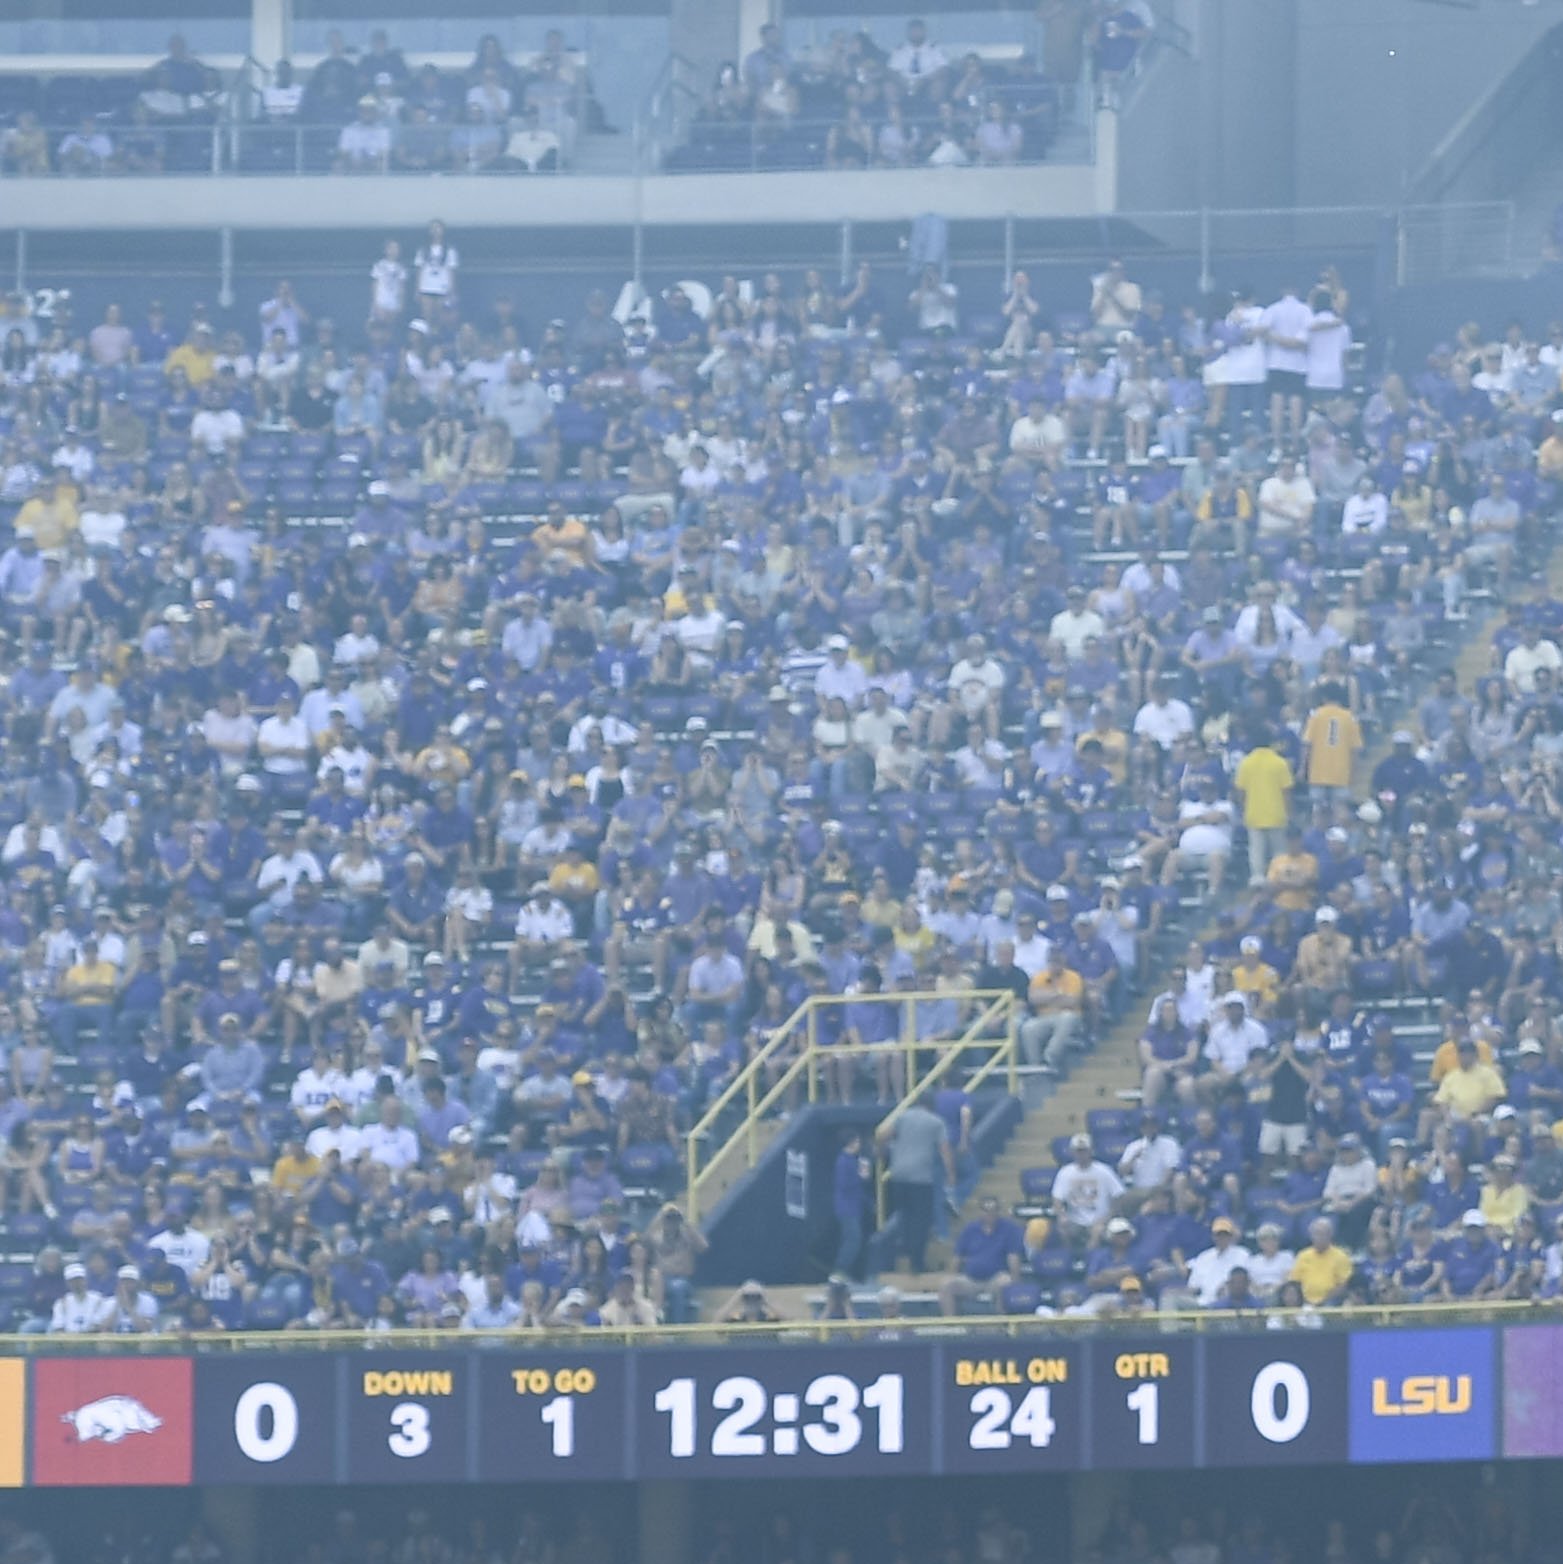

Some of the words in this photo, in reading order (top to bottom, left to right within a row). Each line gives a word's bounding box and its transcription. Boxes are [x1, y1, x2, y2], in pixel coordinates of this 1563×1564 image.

[365, 1371, 452, 1396] DOWN
[514, 1370, 549, 1394] TO
[555, 1369, 596, 1393] GO
[957, 1360, 1021, 1386] BALL
[1028, 1359, 1067, 1383] ON
[1116, 1353, 1169, 1379] QTR
[235, 1382, 298, 1462] 0
[655, 1374, 904, 1457] 12:31
[969, 1386, 1056, 1450] 24
[1127, 1383, 1158, 1444] 1
[1251, 1361, 1309, 1443] 0
[1374, 1377, 1472, 1416] LSU
[388, 1403, 431, 1457] 3
[541, 1396, 573, 1457] 1
